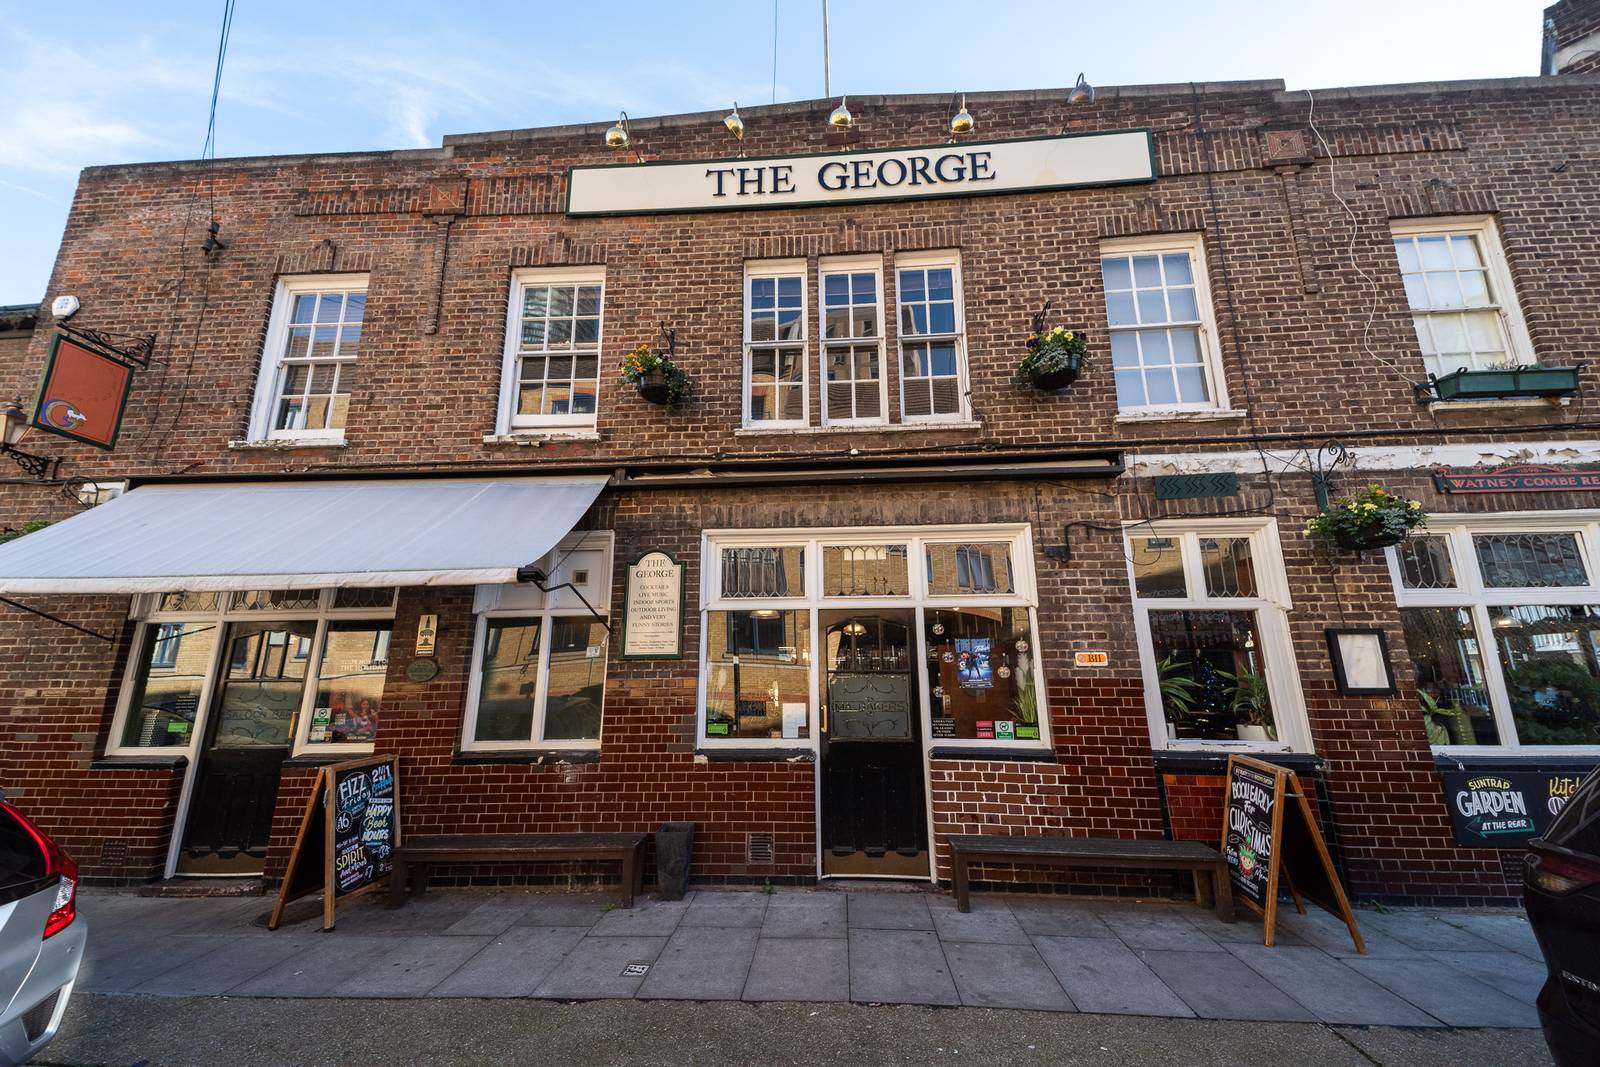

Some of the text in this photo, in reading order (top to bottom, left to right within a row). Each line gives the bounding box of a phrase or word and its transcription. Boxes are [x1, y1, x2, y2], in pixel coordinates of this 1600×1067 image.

[706, 151, 997, 197] THE GEORGE
[1451, 478, 1519, 488] WATNEY
[1523, 477, 1577, 486] COMBE
[646, 559, 666, 568] THE
[635, 570, 675, 578] GEORGE
[339, 773, 367, 801] FIZZ
[1468, 778, 1511, 791] SUNTRAP
[341, 790, 371, 810] Friday
[1232, 781, 1275, 814] BOOK EARLY
[1456, 790, 1527, 818] GARDEN
[365, 803, 393, 817] HAPPY
[1229, 806, 1272, 857] CHRISTMAS
[1482, 819, 1527, 831] AT THE REAR
[336, 846, 365, 872] SPIRIT
